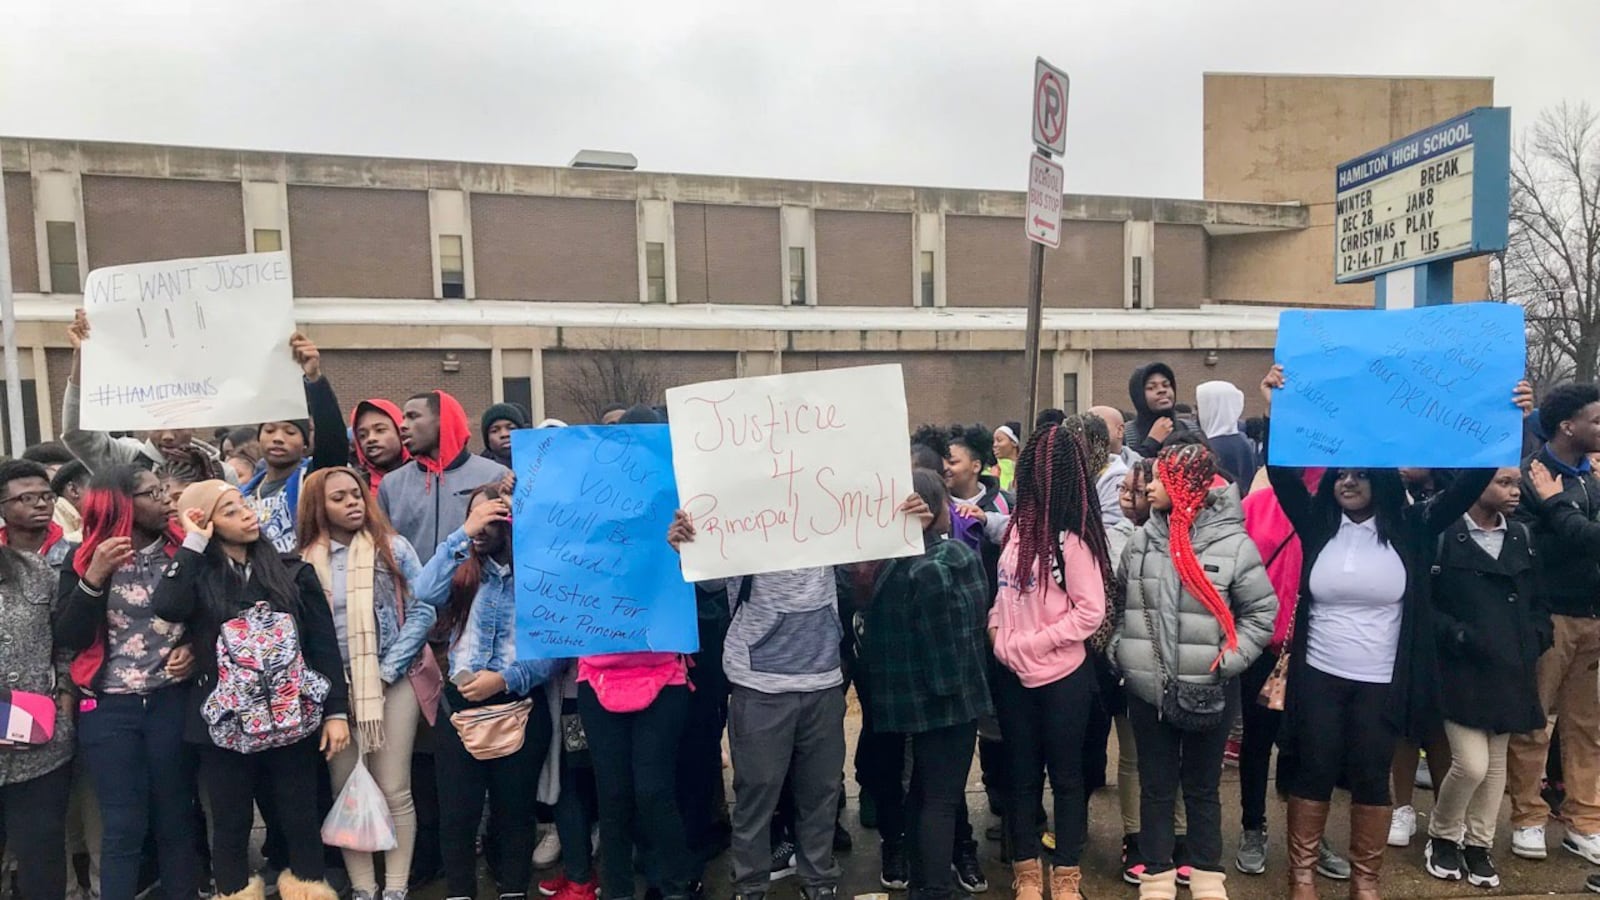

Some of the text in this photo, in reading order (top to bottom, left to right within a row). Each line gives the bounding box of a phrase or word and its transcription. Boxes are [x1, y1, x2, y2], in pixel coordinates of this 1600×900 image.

[1339, 122, 1473, 188] HAMILTON HIGH SCHOOL
[1030, 187, 1060, 214] BUS STOP
[1034, 166, 1060, 193] SCHOOL
[1336, 157, 1459, 215] WINTER BREAK
[1341, 210, 1434, 253] CHRISTMAS PLAY
[1343, 214, 1358, 233] DEC
[1361, 209, 1373, 228] 28
[1343, 246, 1384, 272] 12-14-17
[1392, 240, 1406, 259] AT
[91, 260, 288, 303] WE WANT JUSTICE
[1368, 359, 1401, 385] our
[1443, 344, 1484, 381] okay
[594, 429, 655, 483] Our
[772, 450, 804, 507] 4
[810, 467, 918, 550] Smith
[523, 564, 649, 618] Justice For
[529, 629, 585, 648] #Justice
